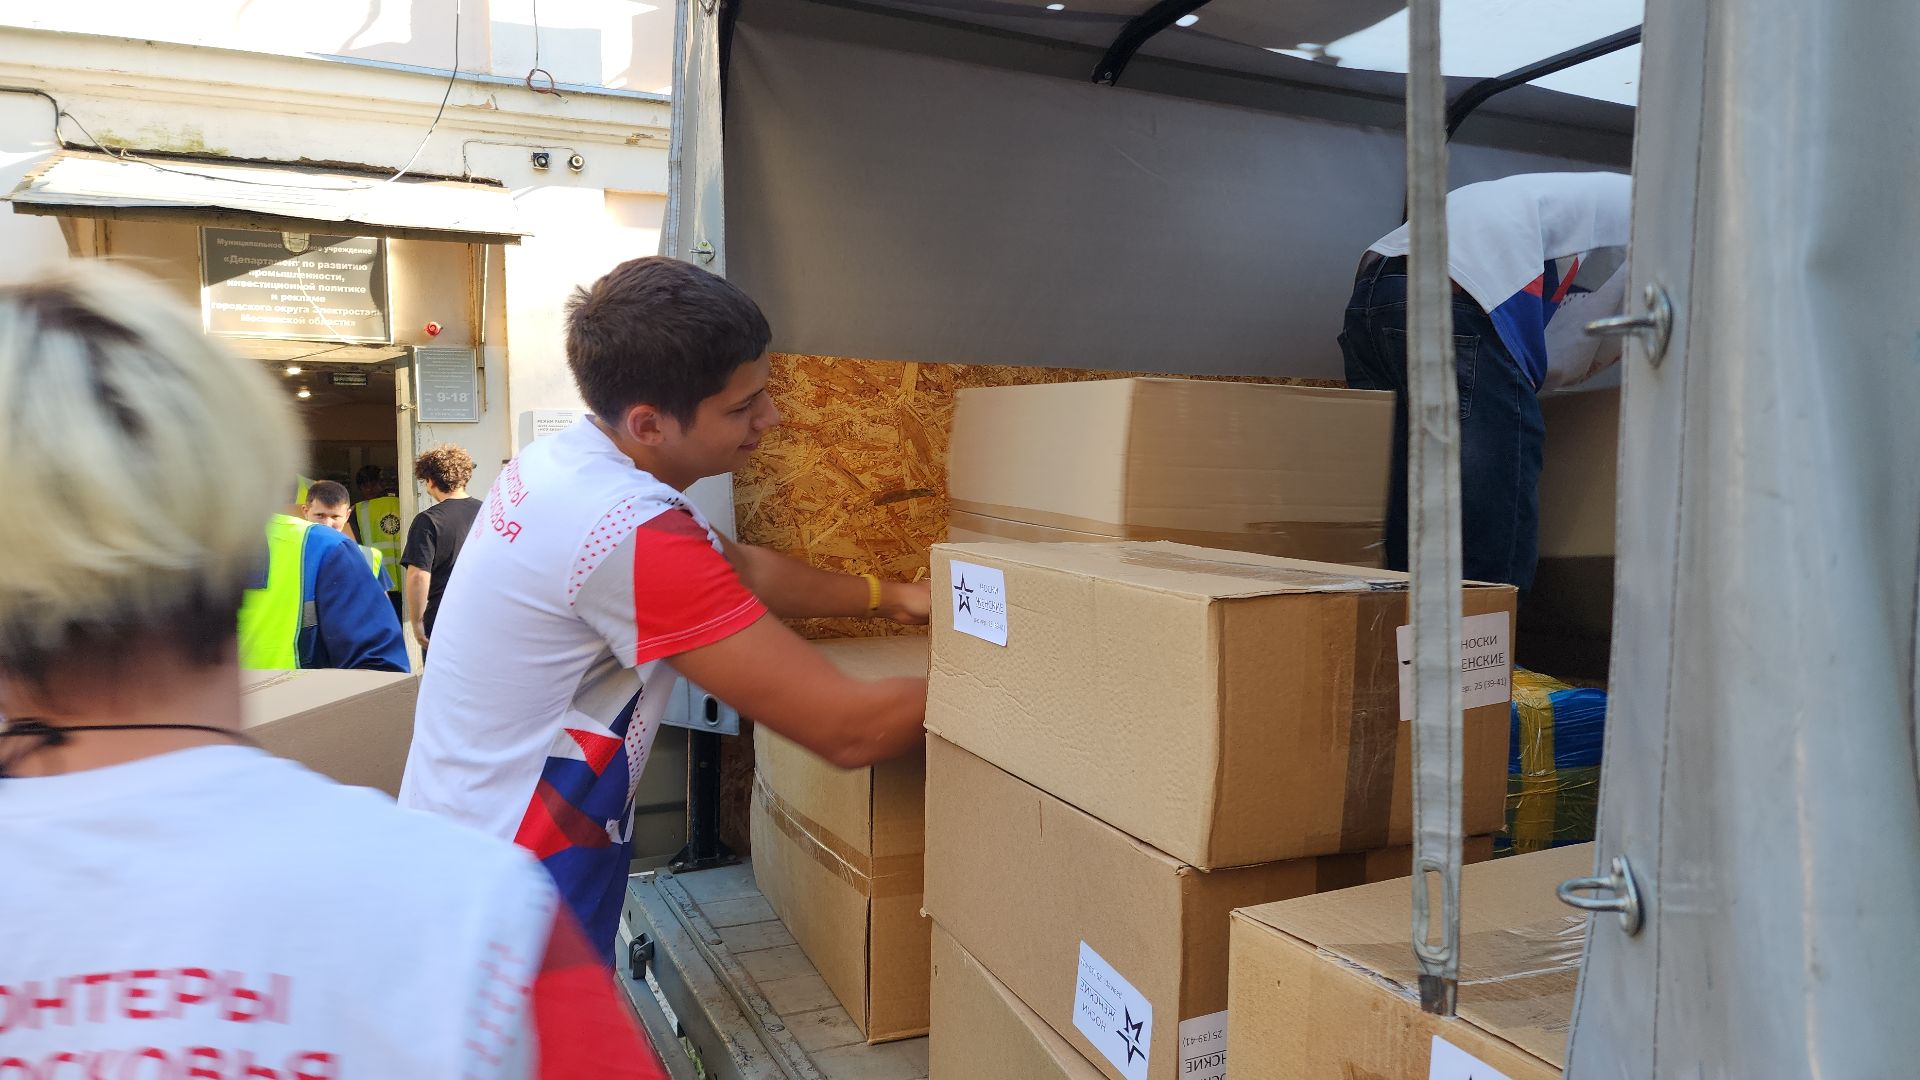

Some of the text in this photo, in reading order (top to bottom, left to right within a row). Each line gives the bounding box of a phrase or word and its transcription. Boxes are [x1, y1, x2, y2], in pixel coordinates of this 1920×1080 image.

[302, 260, 315, 268] по
[318, 261, 368, 271] развитию
[318, 284, 367, 294] политике
[280, 294, 326, 303] рекламе
[274, 304, 310, 315] округа
[1461, 635, 1497, 650] НОСКИ
[1462, 652, 1504, 670] ЕНСКИЕ
[1474, 682, 1483, 692] 25
[1484, 677, 1507, 692] (39-41)
[1080, 980, 1116, 1021] ЖЕНСКИЕ
[1082, 1002, 1107, 1033] НОСКИ
[1182, 1029, 1223, 1048] 25 (39-41)
[1185, 1053, 1227, 1074] НСКИЕ
